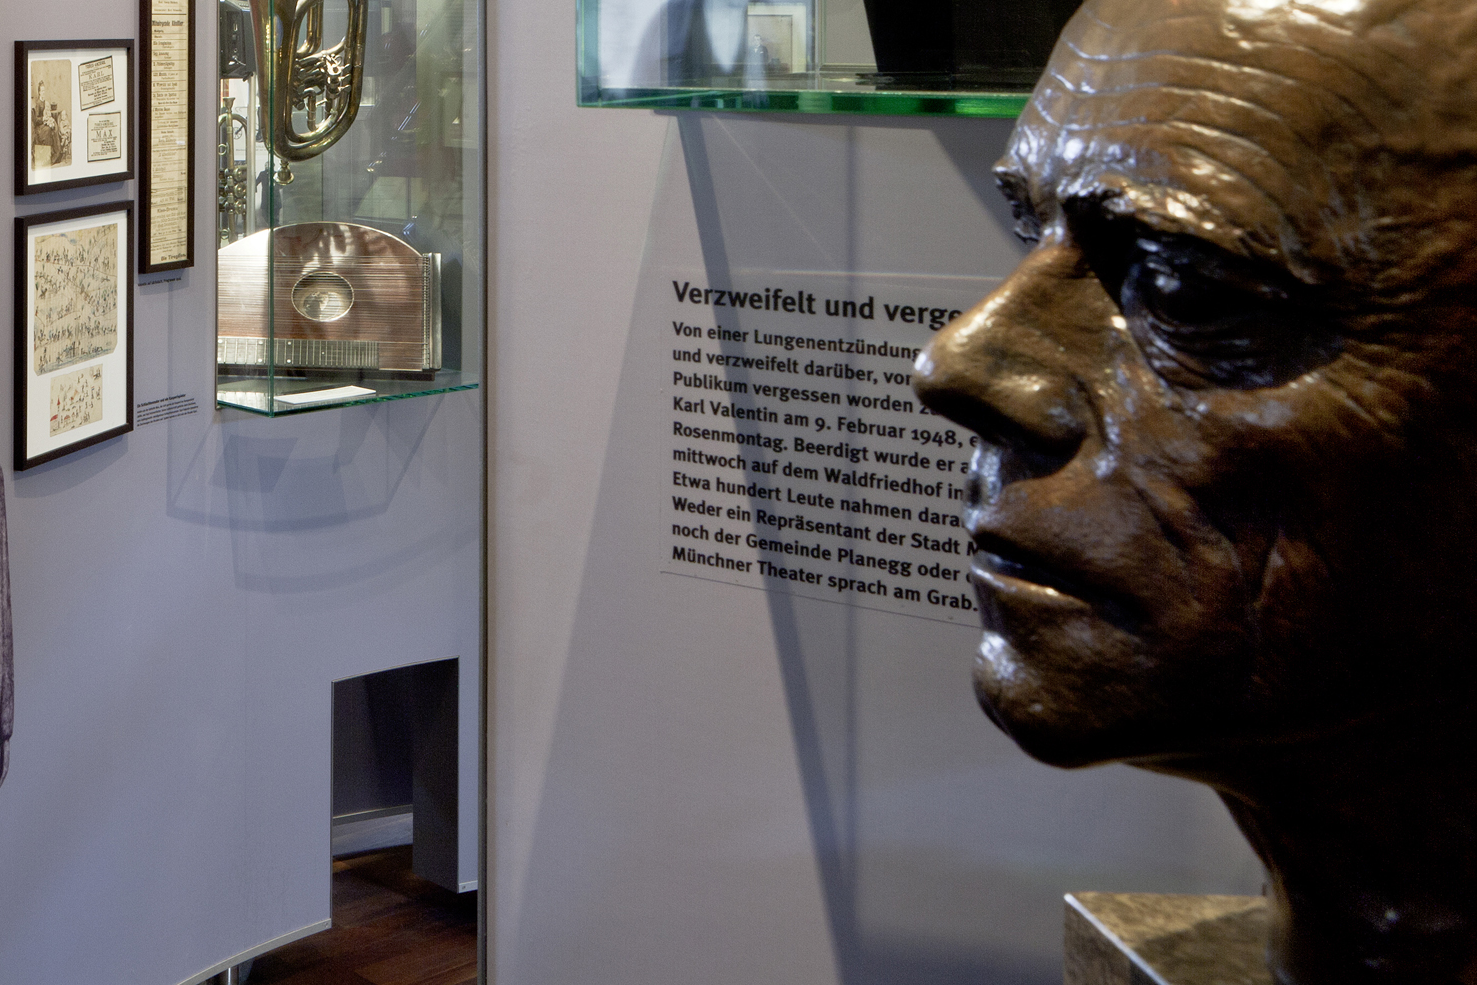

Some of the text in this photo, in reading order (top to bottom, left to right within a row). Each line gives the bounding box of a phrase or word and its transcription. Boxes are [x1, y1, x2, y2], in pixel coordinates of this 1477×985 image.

[89, 70, 105, 80] KARL
[96, 129, 113, 138] MAX
[672, 280, 875, 320] Verzweifelt und
[672, 321, 702, 338] Von
[707, 325, 749, 343] einer
[673, 348, 878, 385] und verzweifelt darüber,
[673, 371, 913, 414] Publikum vergessen worden
[673, 396, 705, 415] Karl
[709, 400, 778, 424] Valentin
[784, 413, 809, 427] am
[815, 417, 831, 433] 9.
[837, 416, 906, 439] Februar
[911, 428, 963, 449] 1948,
[673, 421, 788, 453] Rosenmontag.
[794, 437, 869, 463] Beerdigt
[874, 451, 930, 469] wurde
[936, 458, 955, 472] er
[673, 447, 746, 470] mittwoch
[751, 460, 779, 475] auf
[782, 462, 819, 481] dem
[824, 467, 943, 498] Waldfriedhof
[673, 471, 912, 521] Etwa hundert Leute nahmen
[672, 495, 723, 517] Weder
[726, 505, 751, 522] ein
[756, 509, 871, 541] Repräsentant
[876, 527, 906, 546] der
[910, 532, 961, 555] Stadt
[672, 524, 709, 541] noch
[714, 527, 742, 545] der
[745, 533, 832, 561] Gemeinde
[837, 547, 912, 577] Planegg
[917, 562, 961, 582] oder
[672, 545, 978, 612] Münchner Theater sprach am Grab.
